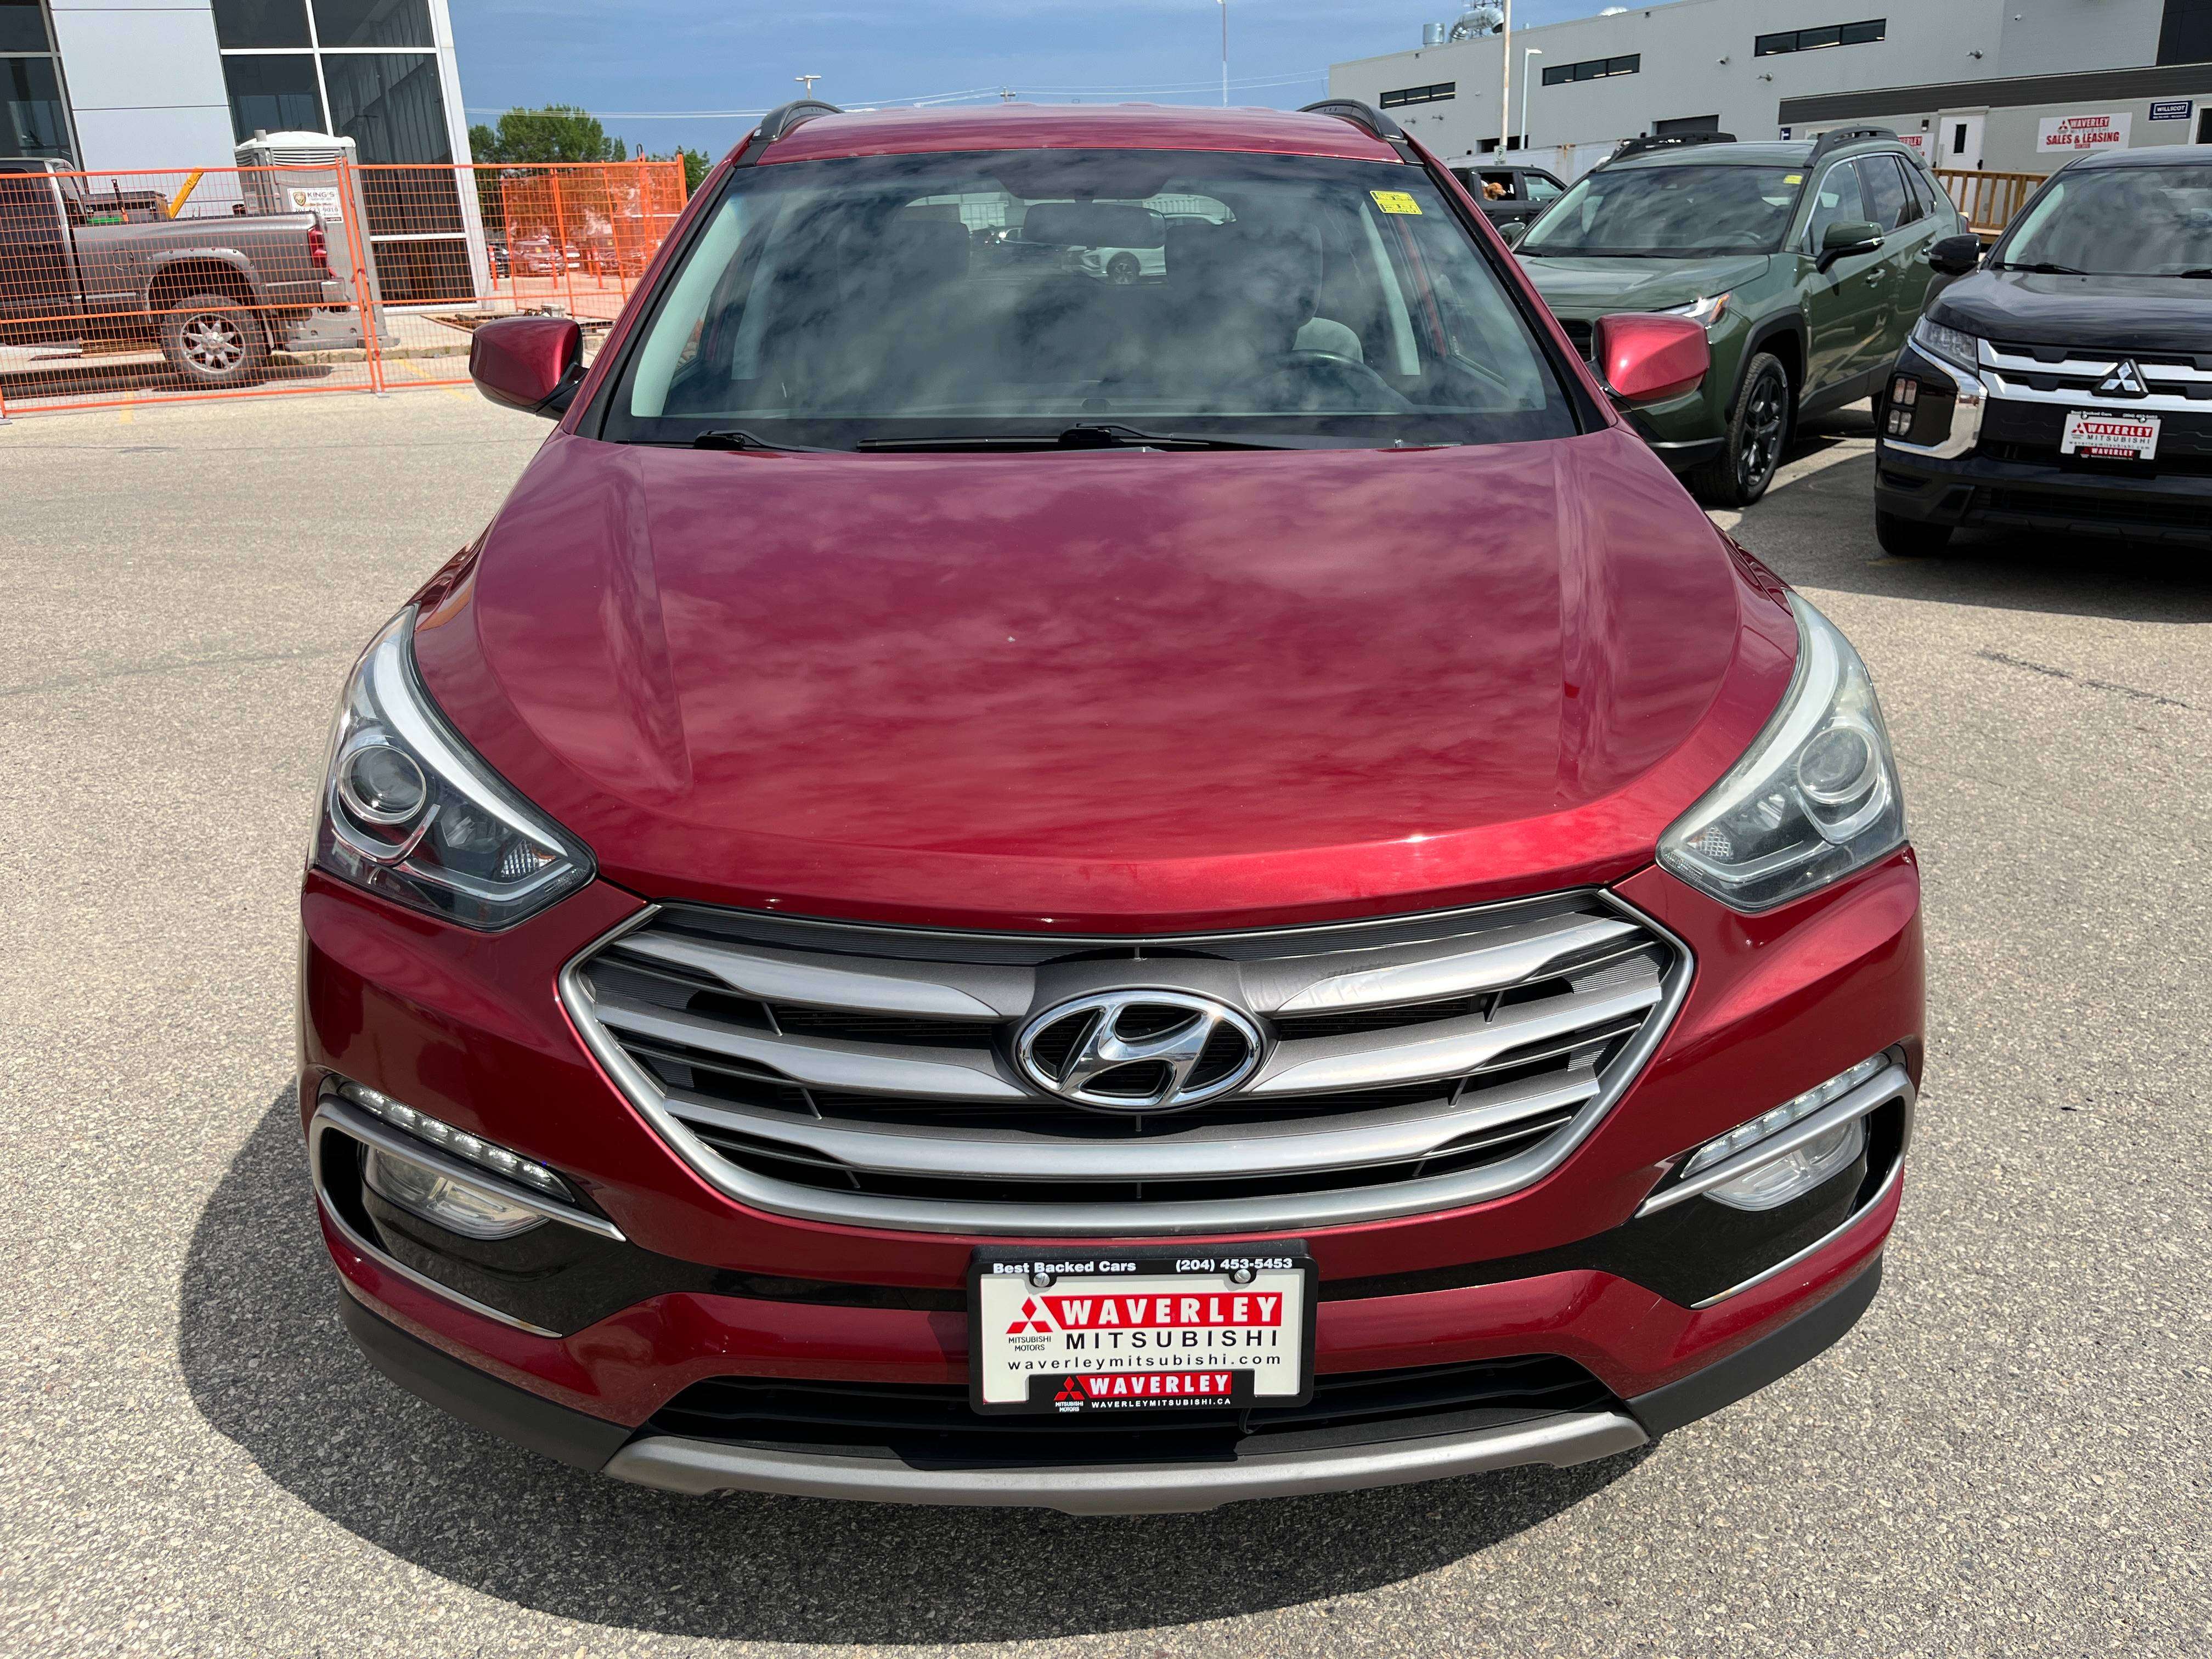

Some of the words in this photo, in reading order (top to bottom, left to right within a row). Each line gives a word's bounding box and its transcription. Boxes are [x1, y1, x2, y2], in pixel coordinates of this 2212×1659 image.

[2069, 117, 2109, 128] WAVERLEY
[2046, 134, 2072, 145] SALES
[2074, 135, 2080, 143] &
[2083, 132, 2120, 143] LEASING
[2087, 424, 2152, 436] WAVERLEY
[2087, 435, 2151, 444] MITSUBISHI
[2091, 447, 2133, 456] WAVERLEY
[993, 1262, 1029, 1274] Best
[1034, 1261, 1096, 1273] Backed
[1099, 1260, 1136, 1272] Cars
[1175, 1259, 1215, 1272] (204)
[1220, 1258, 1293, 1270] 453-5453
[1062, 1296, 1278, 1326] WAVERLEY
[1008, 1335, 1052, 1344] MITSUBISHI
[1066, 1330, 1277, 1350] MITSUBISHI
[1007, 1353, 1281, 1370] waverleymitsubishi.com
[1090, 1374, 1228, 1395] WAVERLEY
[1091, 1398, 1231, 1408] WAVERLEYMITSUBISHI.CA
